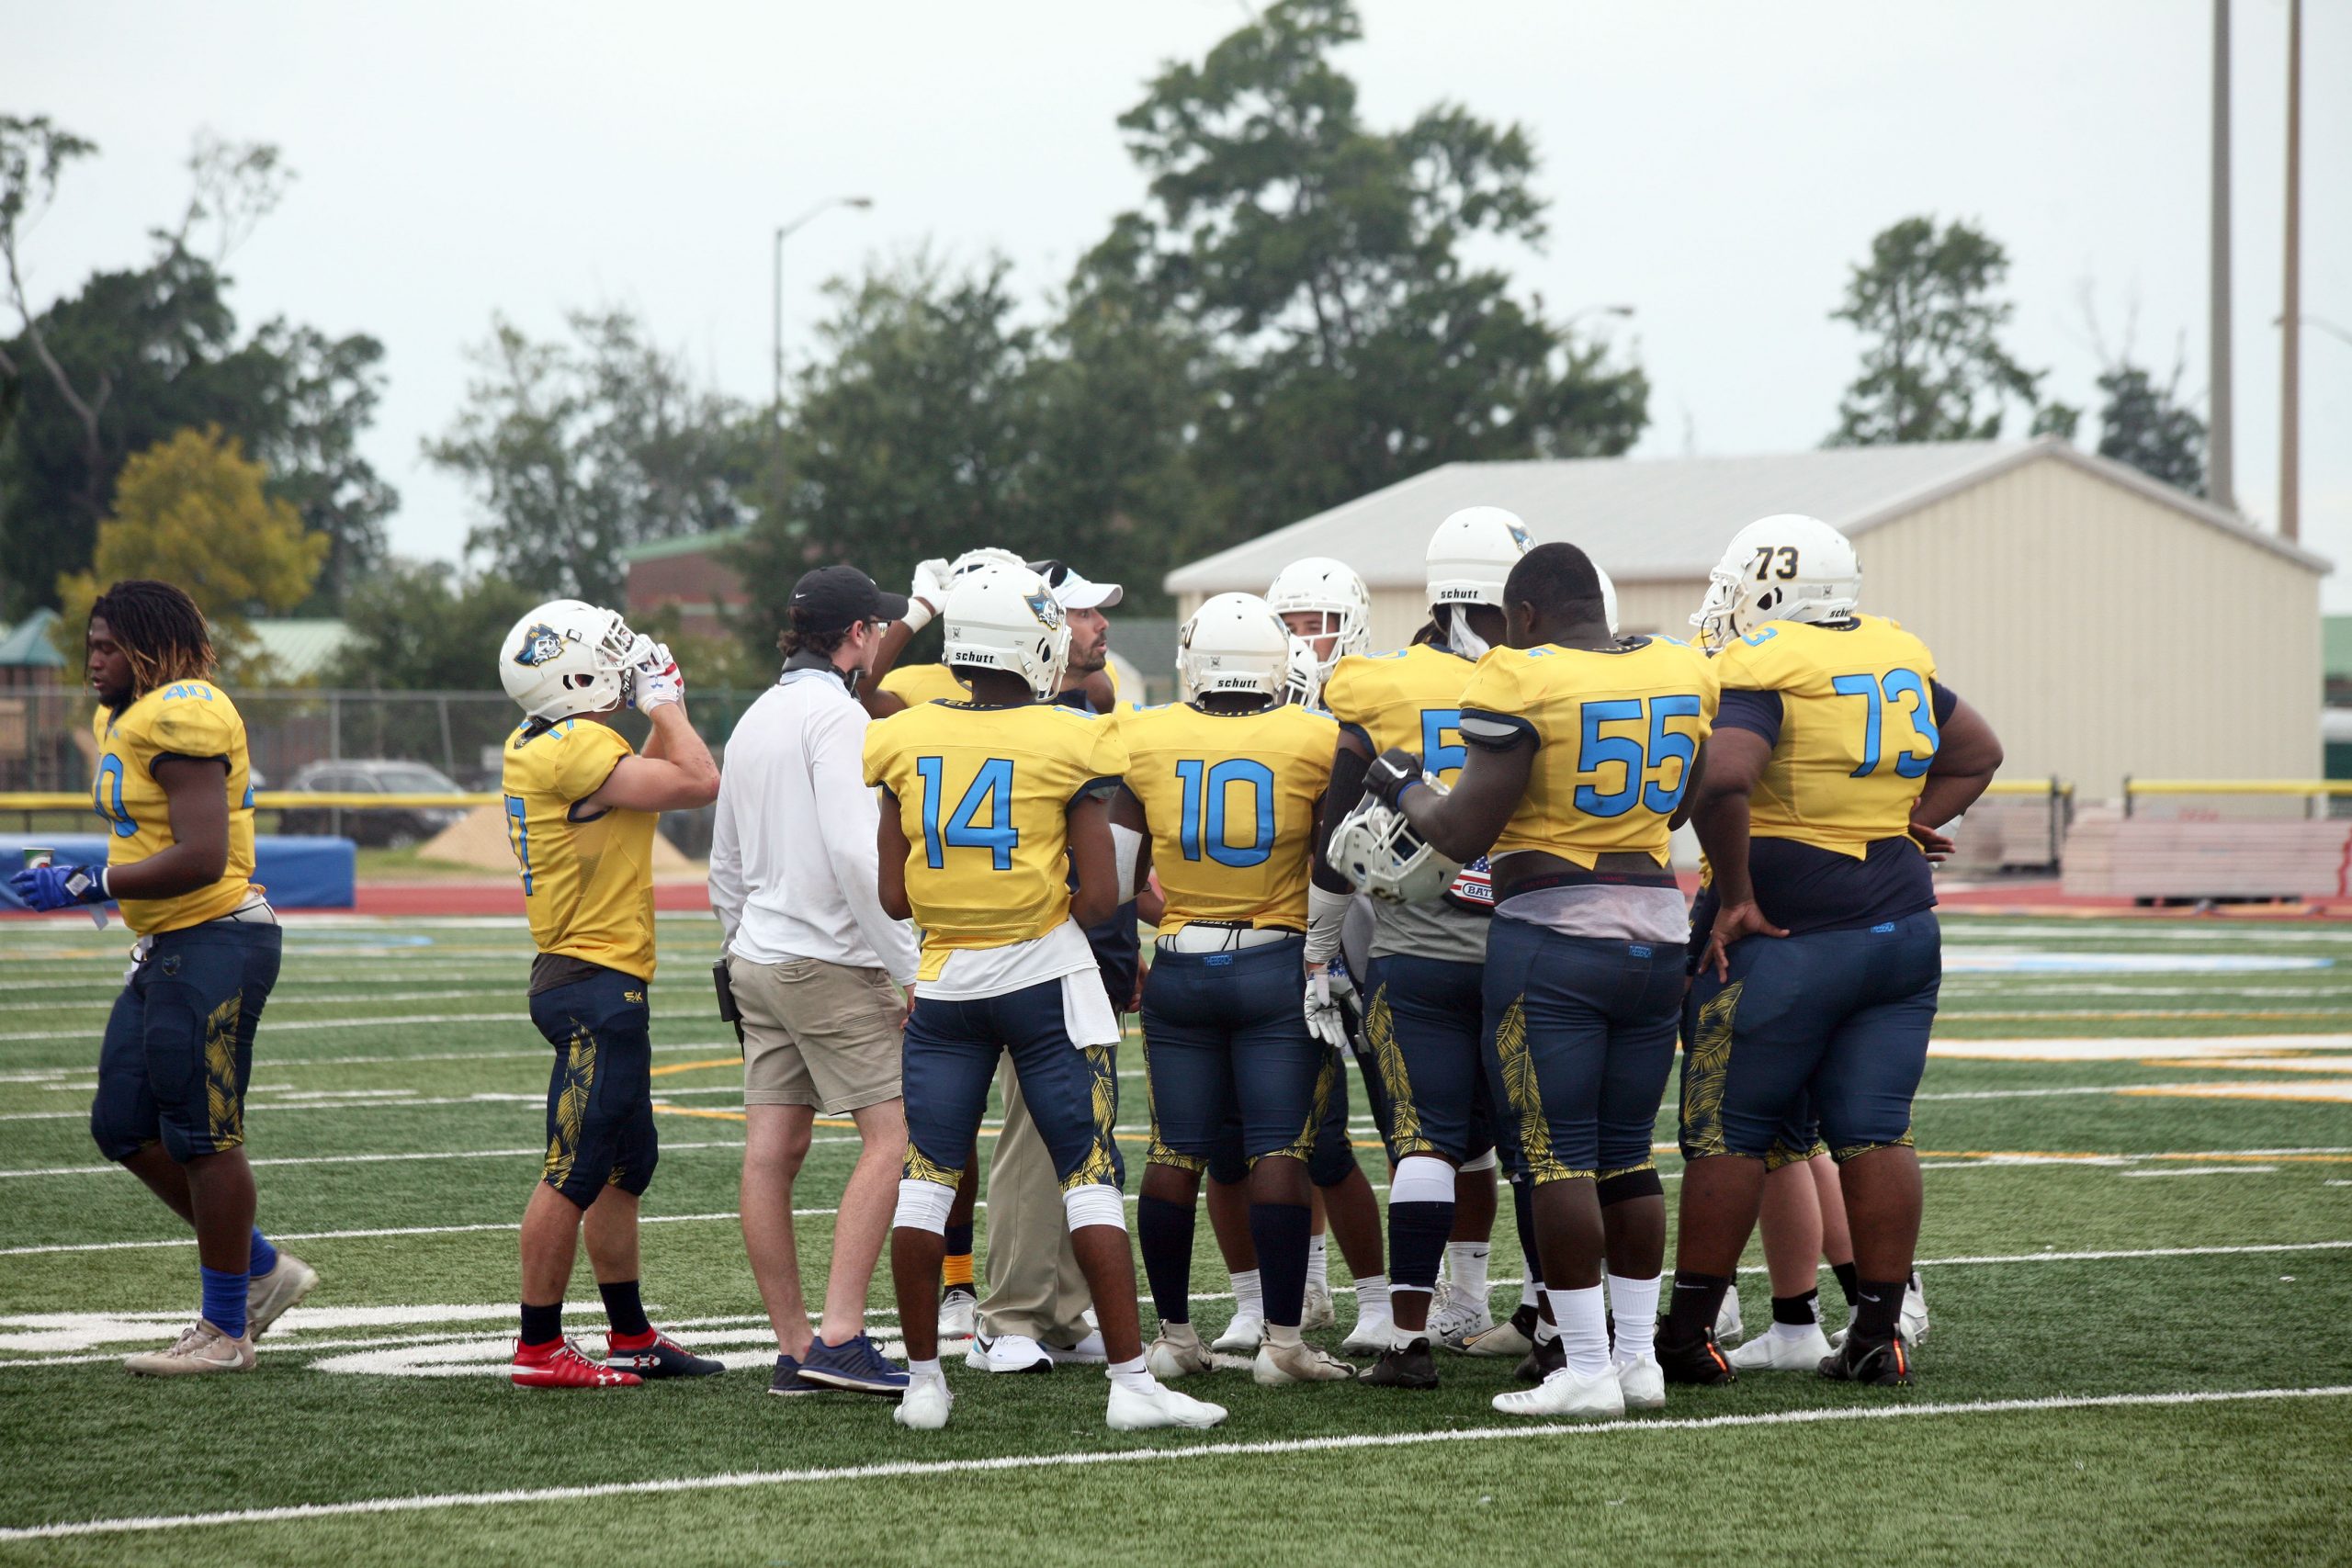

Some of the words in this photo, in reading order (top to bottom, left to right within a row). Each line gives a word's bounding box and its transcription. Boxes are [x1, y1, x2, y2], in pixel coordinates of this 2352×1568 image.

[1756, 546, 1799, 581] 73
[1440, 588, 1478, 599] schutt
[956, 650, 995, 664] schutt
[163, 683, 213, 701] 40
[1217, 677, 1258, 689] schutt
[1832, 668, 1940, 779] 73
[1574, 694, 1701, 818] 55
[917, 756, 1019, 871] 14
[1175, 758, 1276, 868] 10
[1467, 886, 1493, 897] BAT
